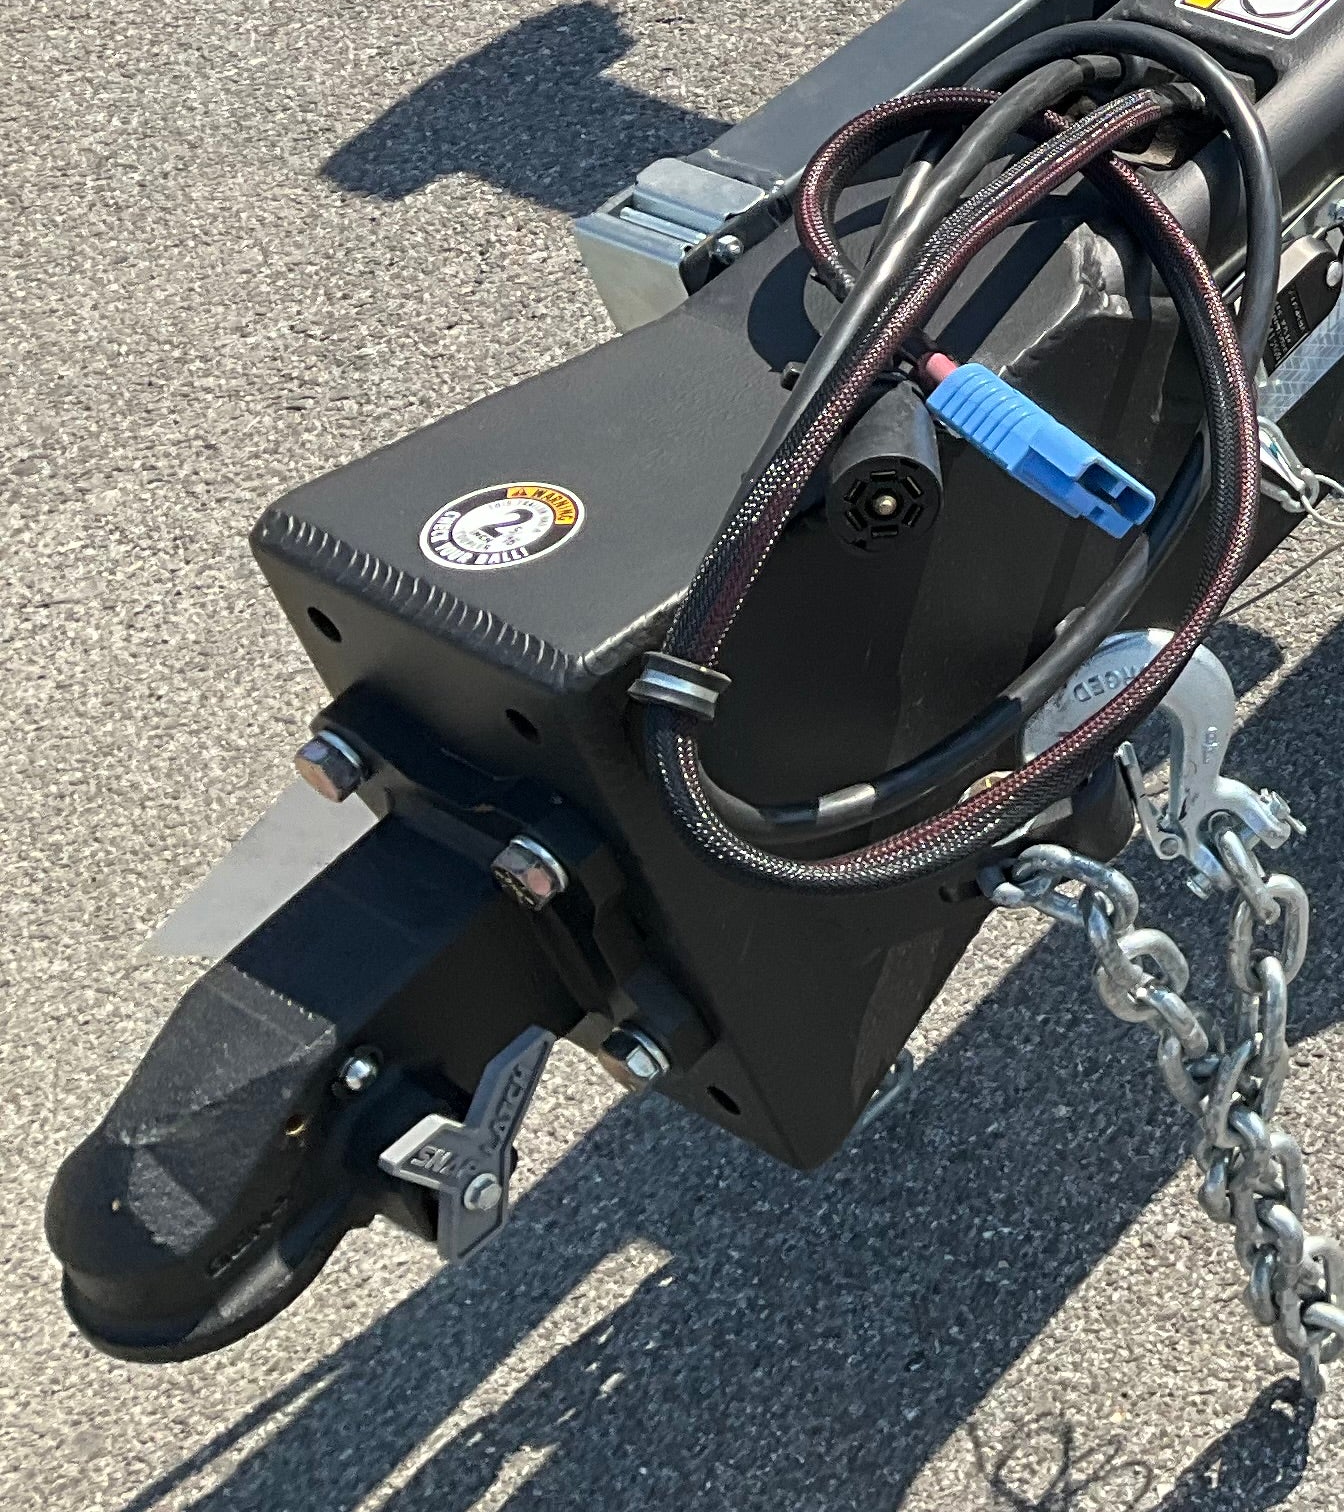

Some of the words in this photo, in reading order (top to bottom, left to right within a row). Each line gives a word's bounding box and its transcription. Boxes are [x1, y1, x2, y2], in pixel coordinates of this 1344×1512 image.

[533, 489, 574, 521] WARNING
[479, 509, 533, 538] 2
[434, 541, 474, 564] YOUR
[410, 1145, 480, 1178] SNAP
